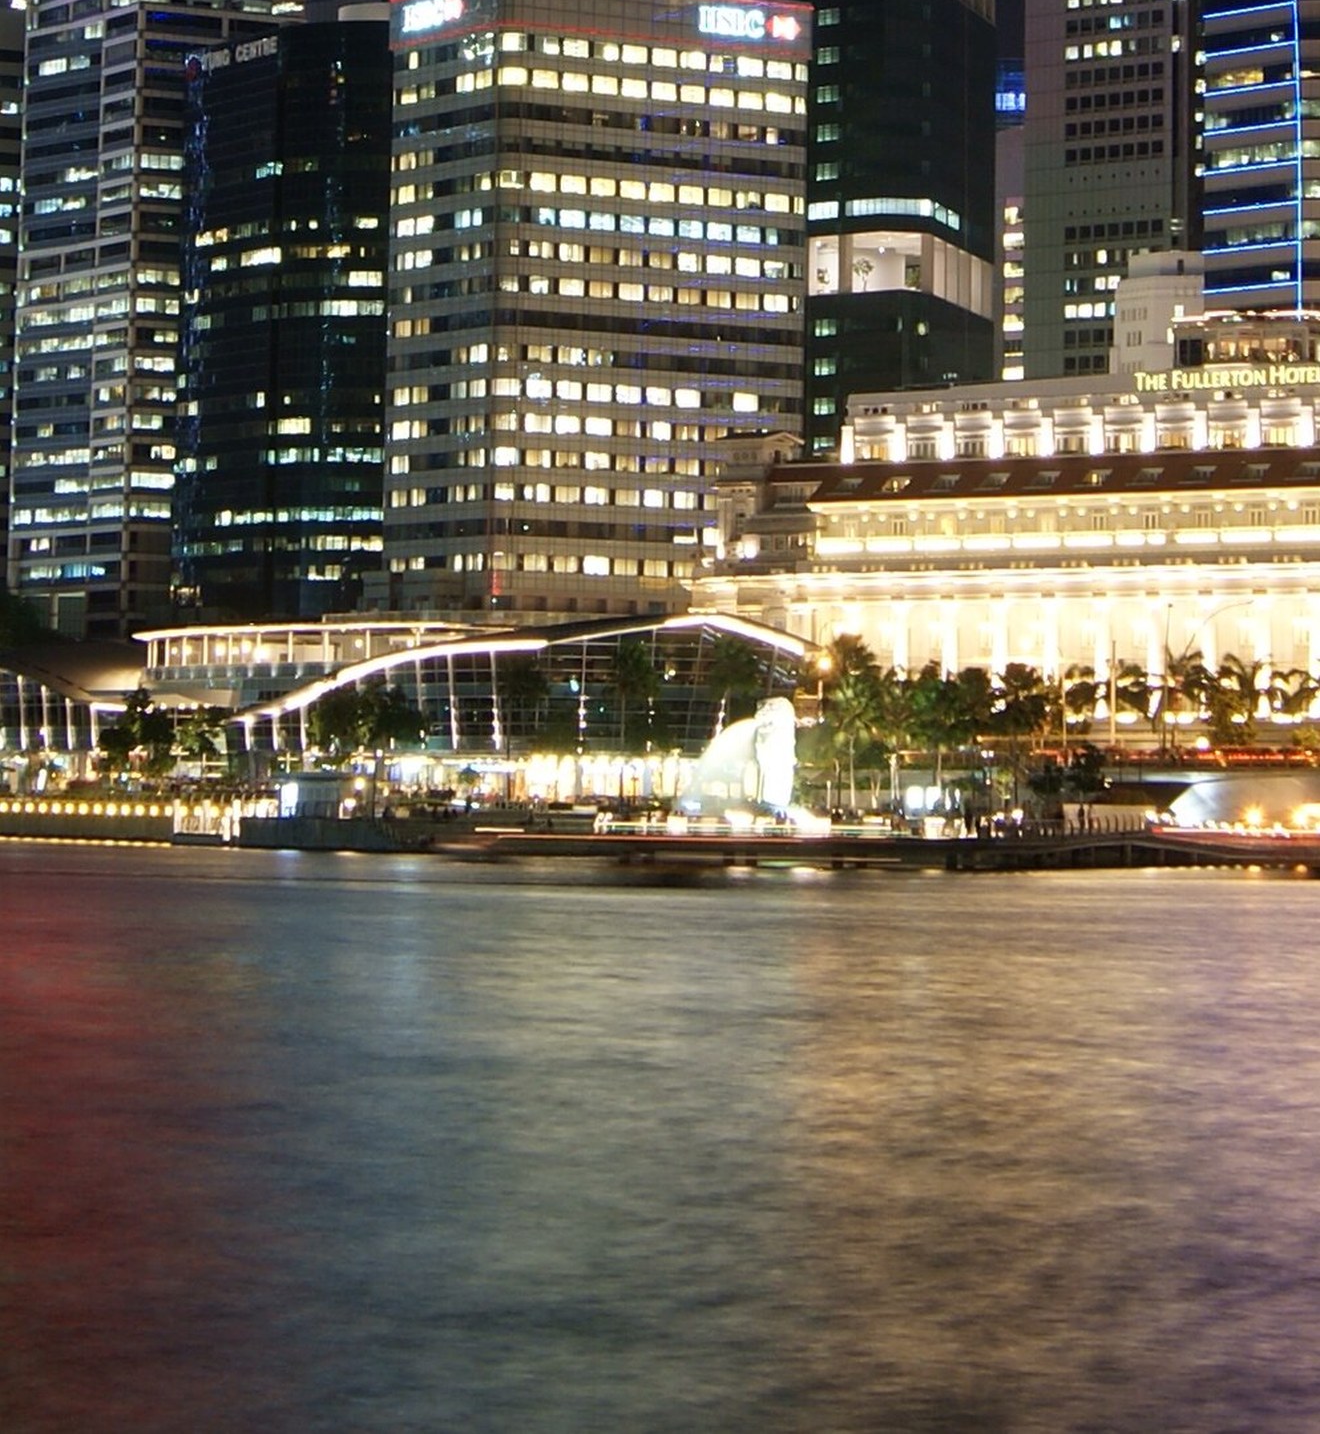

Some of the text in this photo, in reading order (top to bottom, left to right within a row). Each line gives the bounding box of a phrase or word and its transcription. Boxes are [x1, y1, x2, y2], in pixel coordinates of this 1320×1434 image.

[699, 5, 765, 39] HSBC
[235, 36, 278, 62] CENTRE
[1134, 372, 1167, 391] THE
[1171, 369, 1267, 390] FULLERTON
